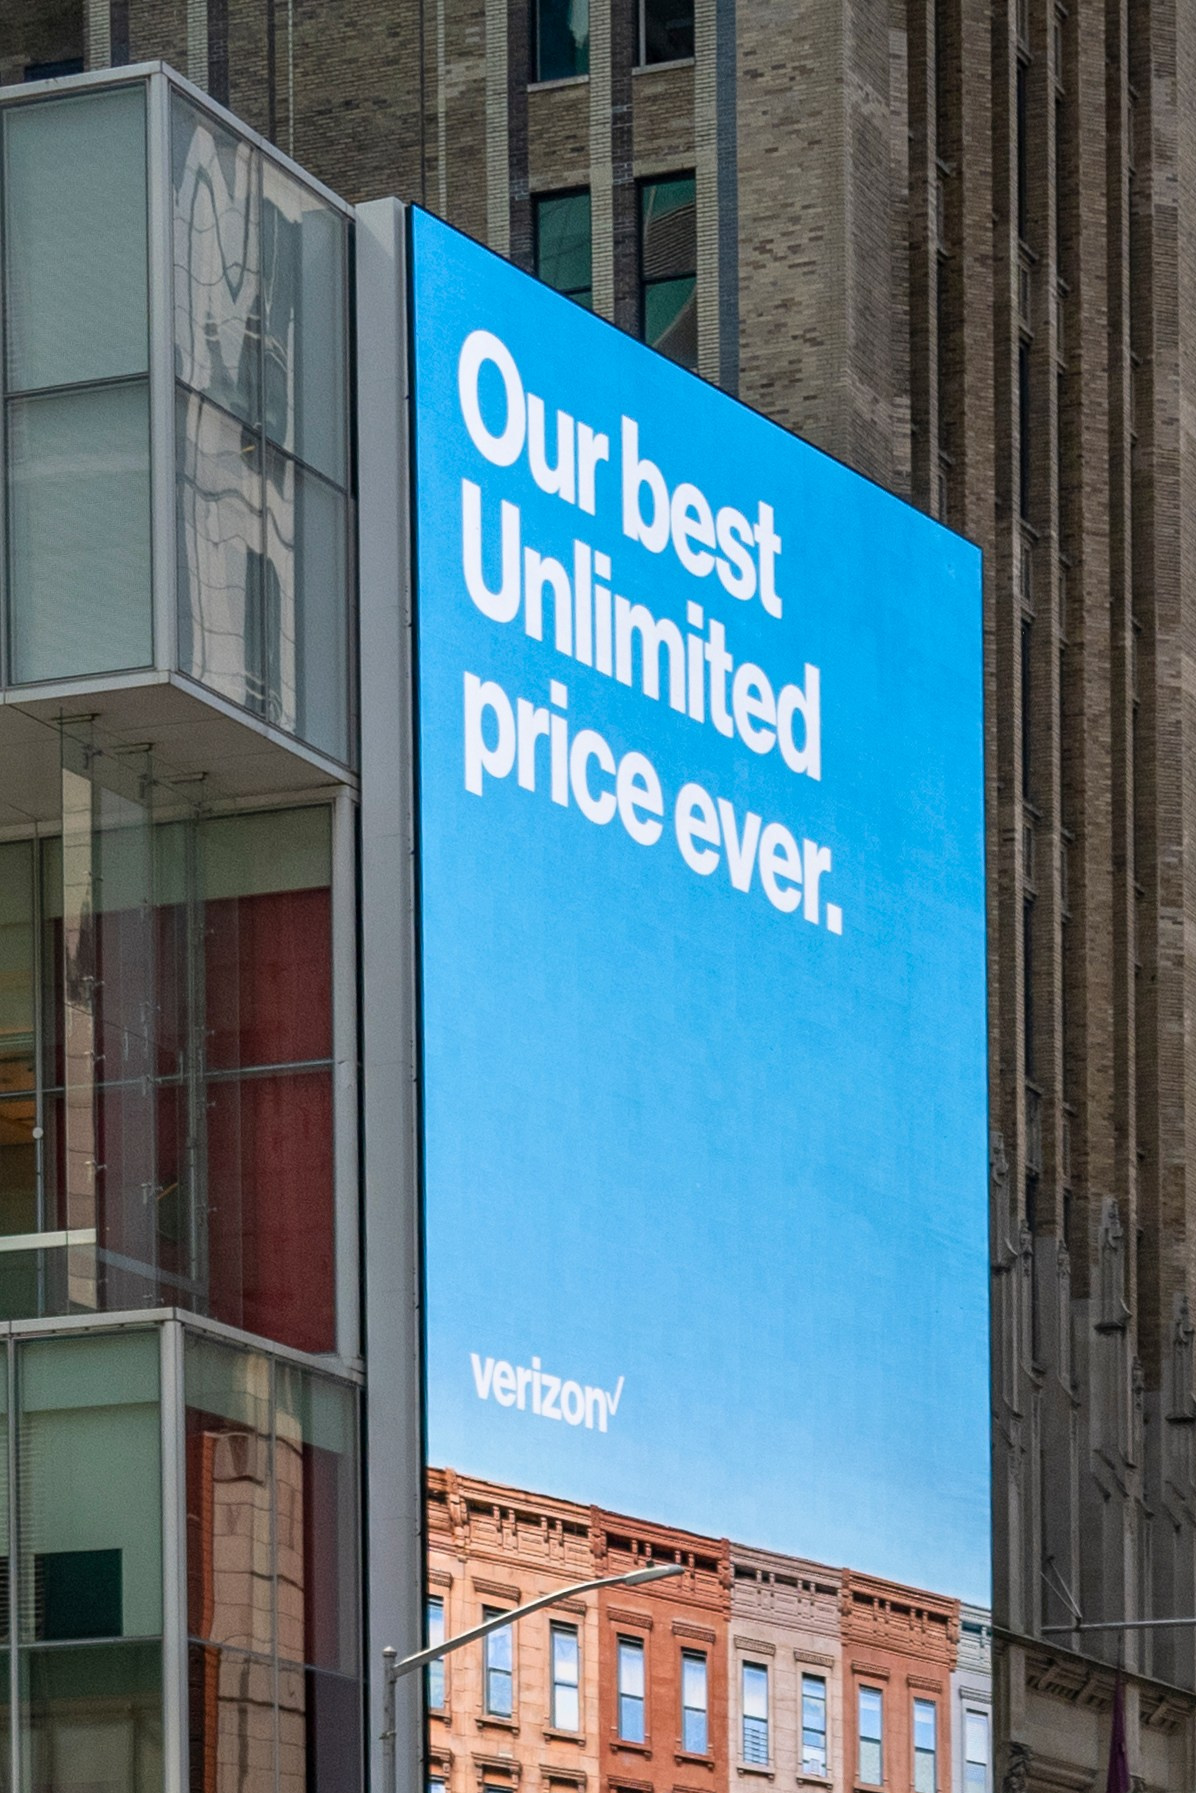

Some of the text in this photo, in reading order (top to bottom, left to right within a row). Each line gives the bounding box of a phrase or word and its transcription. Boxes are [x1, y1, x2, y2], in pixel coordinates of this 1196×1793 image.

[458, 330, 783, 619] Our best
[462, 478, 821, 782] Unlimited
[464, 670, 843, 934] price ever.
[470, 1352, 608, 1433] verizon
